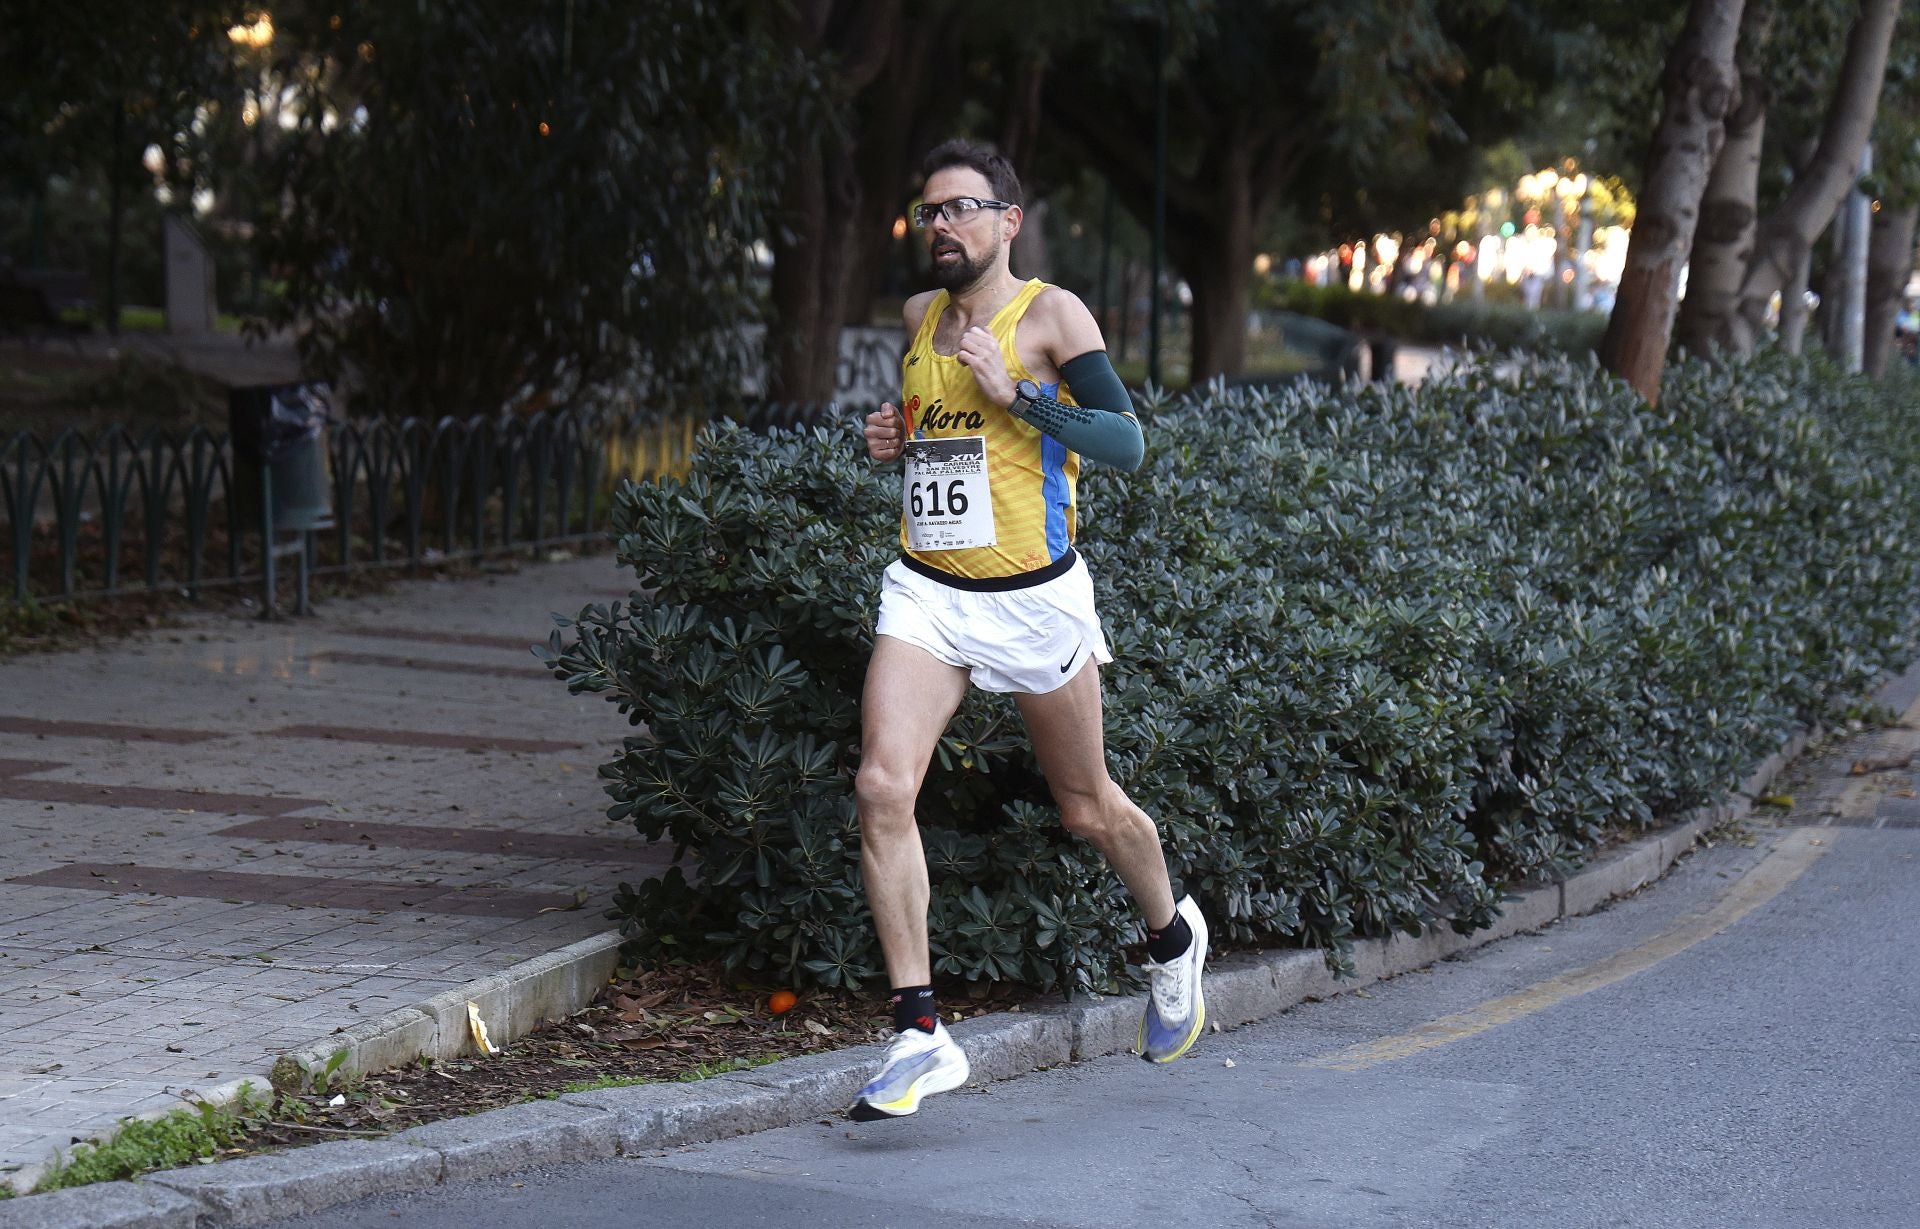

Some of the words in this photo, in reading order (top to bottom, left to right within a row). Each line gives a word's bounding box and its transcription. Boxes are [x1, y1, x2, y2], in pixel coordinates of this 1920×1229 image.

[920, 399, 985, 430] Álora
[949, 453, 983, 461] XIV
[911, 480, 968, 517] 616
